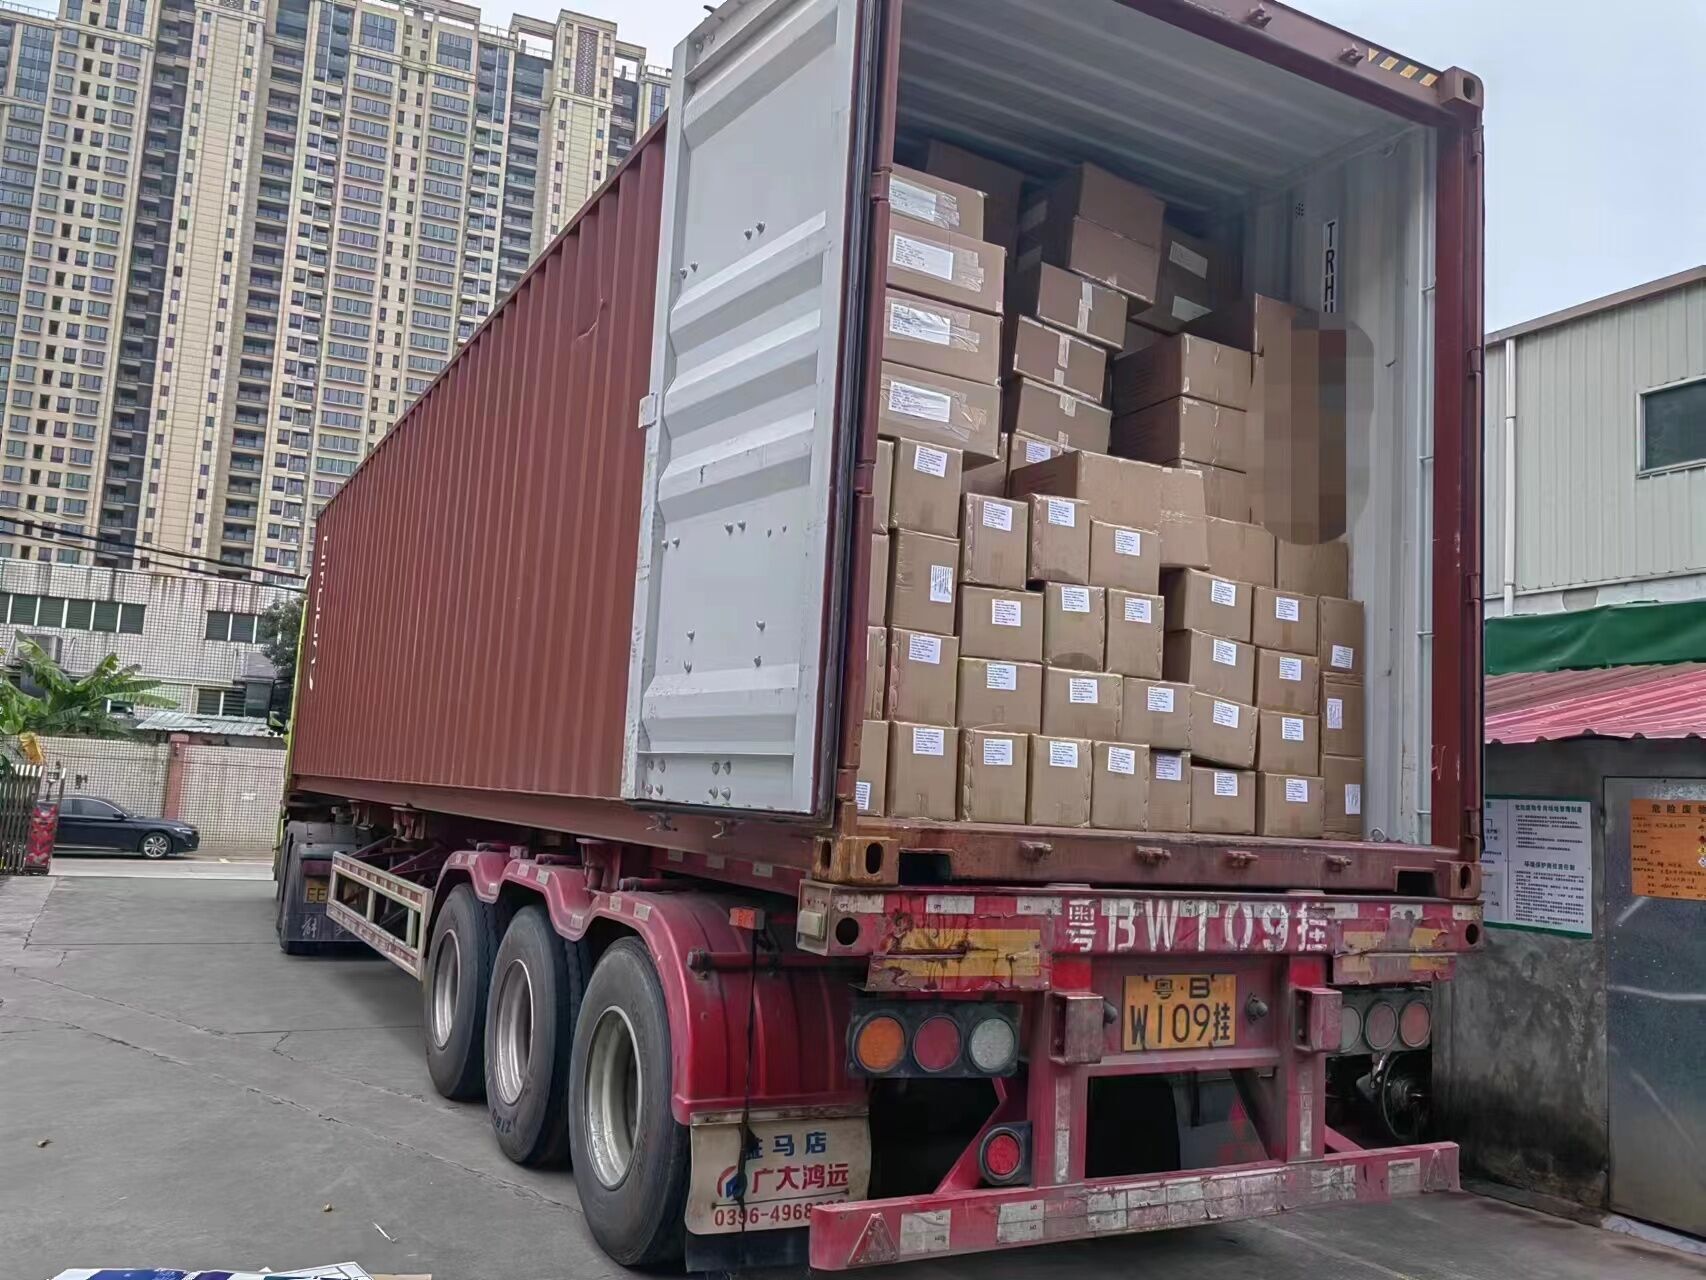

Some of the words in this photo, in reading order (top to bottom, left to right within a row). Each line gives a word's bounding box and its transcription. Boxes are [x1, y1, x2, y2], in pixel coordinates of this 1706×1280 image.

[1130, 1003, 1231, 1046] W109挂
[752, 1163, 849, 1194] 广大鸿远
[714, 1199, 846, 1227] 0396-4968
